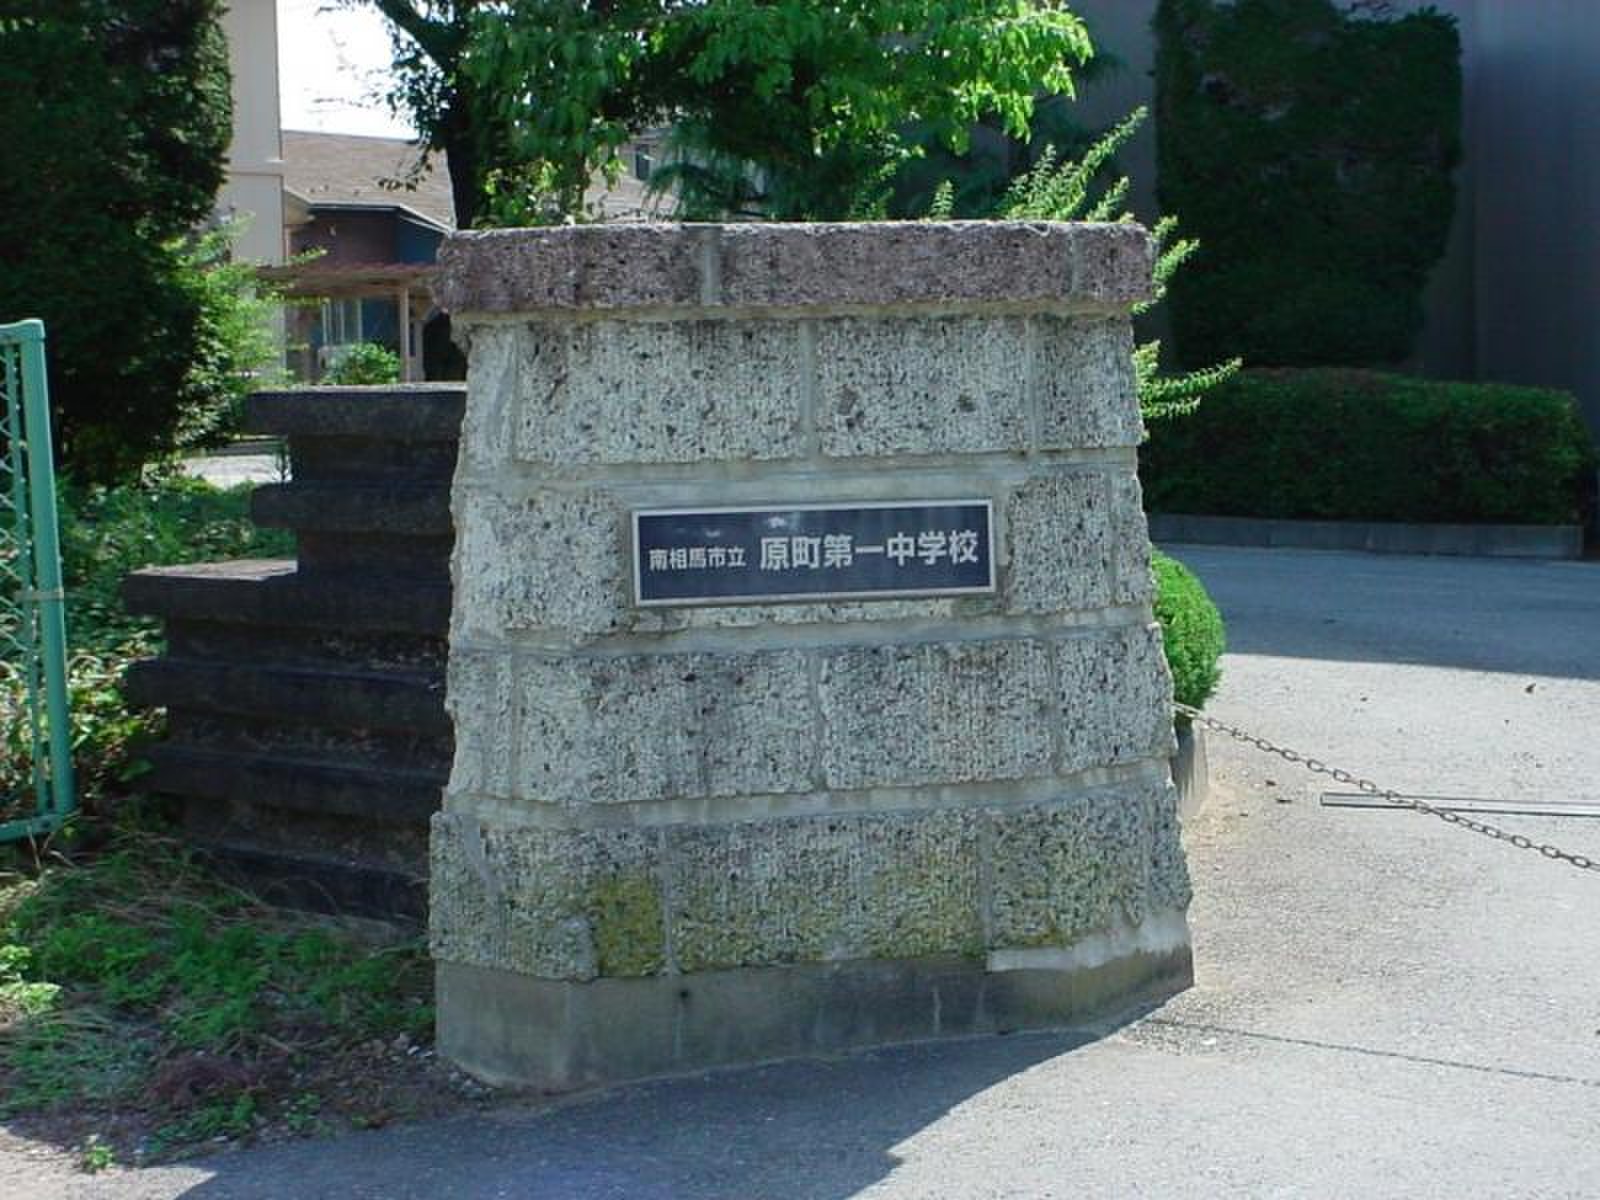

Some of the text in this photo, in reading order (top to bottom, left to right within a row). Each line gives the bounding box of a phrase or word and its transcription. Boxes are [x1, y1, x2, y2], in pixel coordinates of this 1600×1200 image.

[649, 529, 979, 571] 南相馬市立 原町第一中学校
